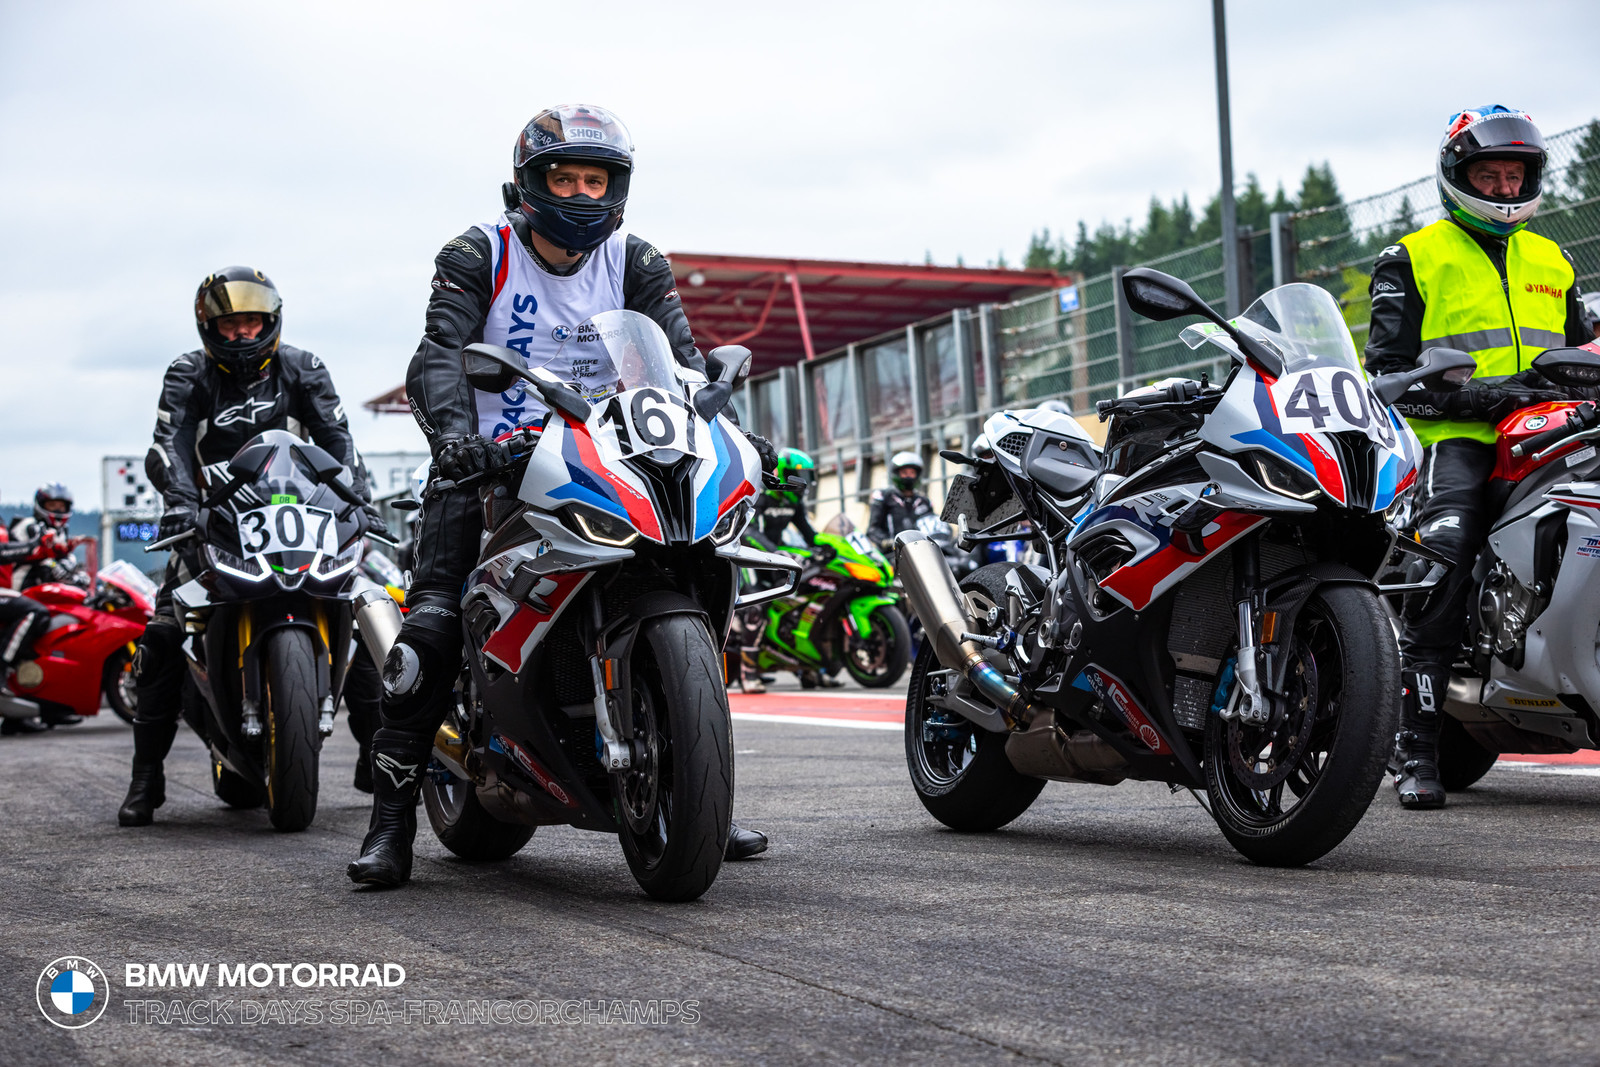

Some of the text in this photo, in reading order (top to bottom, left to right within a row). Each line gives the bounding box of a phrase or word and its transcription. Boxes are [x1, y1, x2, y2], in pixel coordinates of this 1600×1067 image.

[569, 128, 603, 140] SHOEI
[597, 388, 697, 457] 167
[1284, 371, 1396, 449] 409
[240, 505, 333, 553] 307
[415, 605, 457, 617] RST
[1086, 674, 1105, 700] GILLES
[1416, 673, 1436, 713] SIDI
[1513, 698, 1557, 707] DUNLOP
